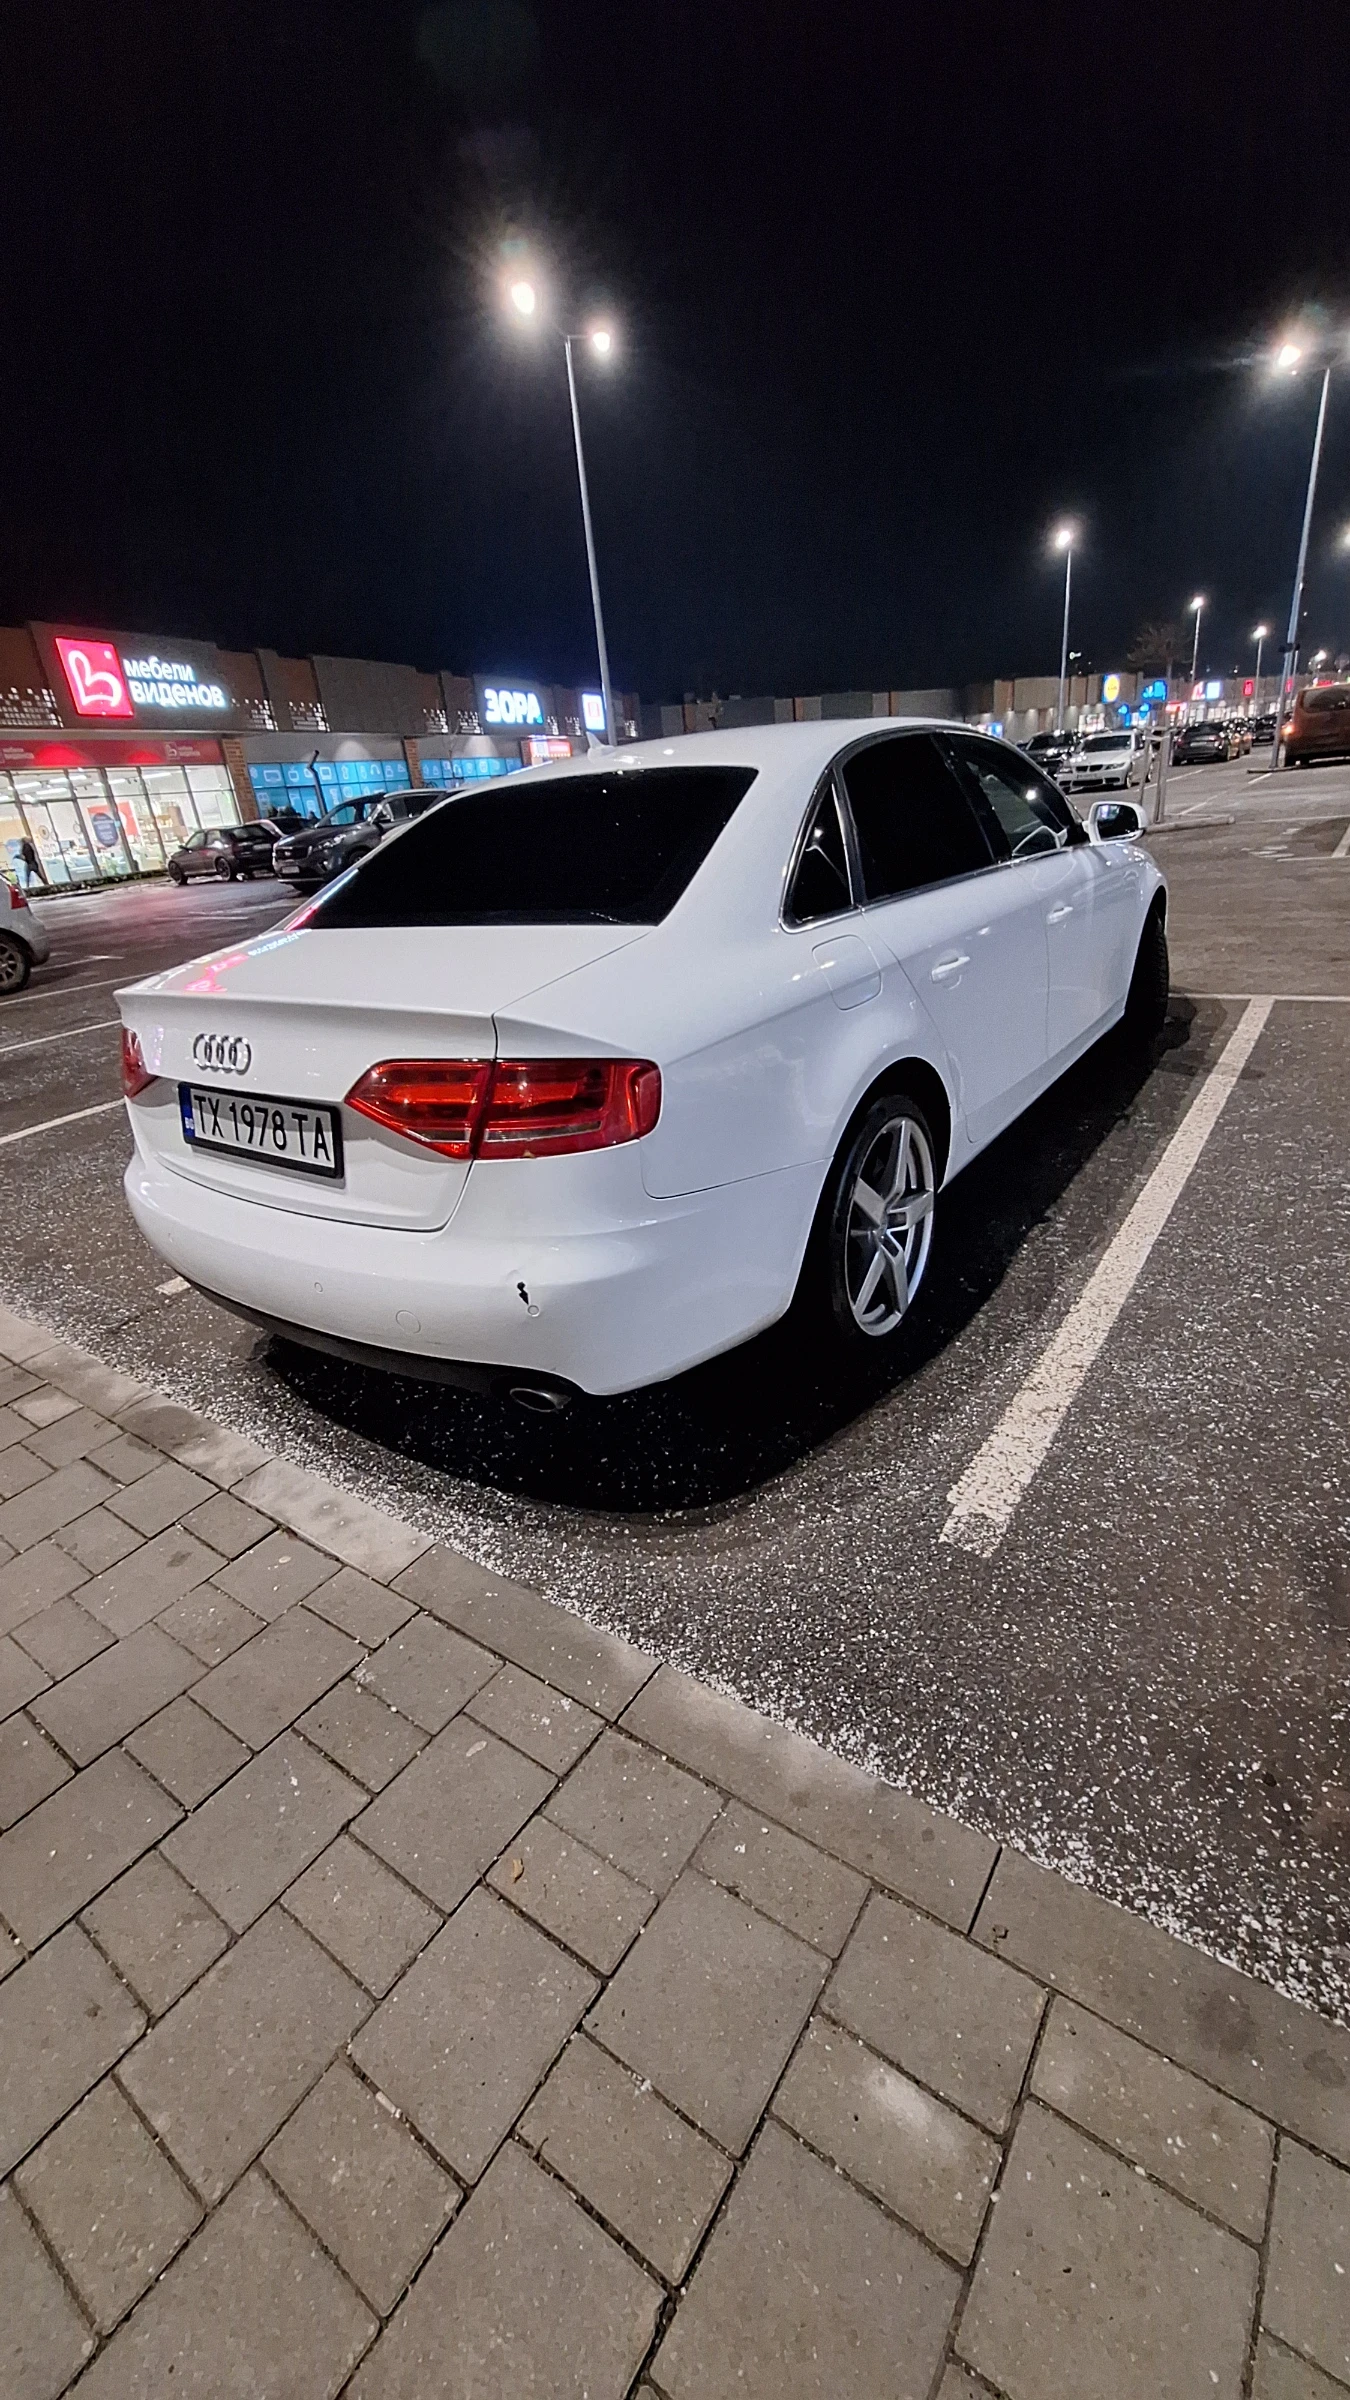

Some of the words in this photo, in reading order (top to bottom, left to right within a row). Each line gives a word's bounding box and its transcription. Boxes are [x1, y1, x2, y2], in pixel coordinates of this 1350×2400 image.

[122, 656, 196, 682] мебели
[484, 688, 545, 725] ЗОРА
[193, 1094, 225, 1138] TX
[229, 1101, 287, 1151] 1978
[291, 1112, 331, 1162] TA
